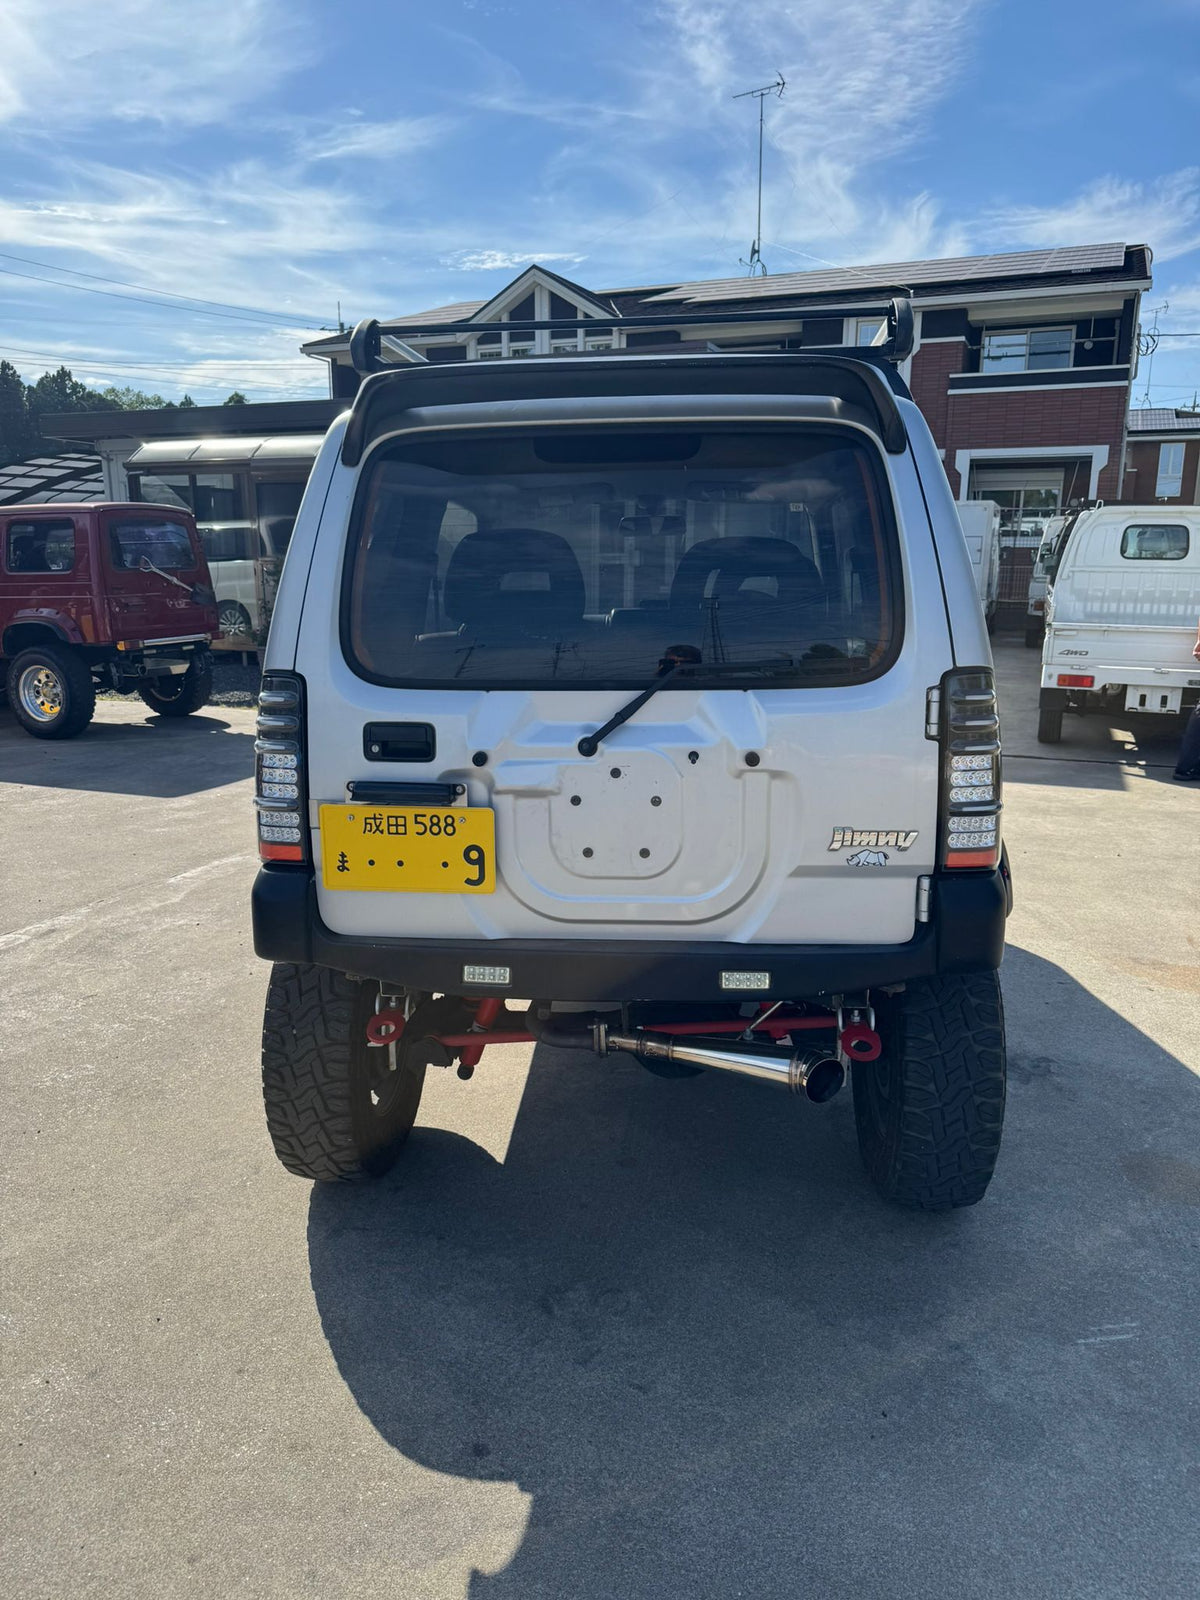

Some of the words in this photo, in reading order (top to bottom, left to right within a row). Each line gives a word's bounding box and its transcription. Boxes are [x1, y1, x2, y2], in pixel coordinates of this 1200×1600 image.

[363, 813, 407, 836] 成田
[414, 814, 457, 836] 588
[336, 851, 351, 873] ま
